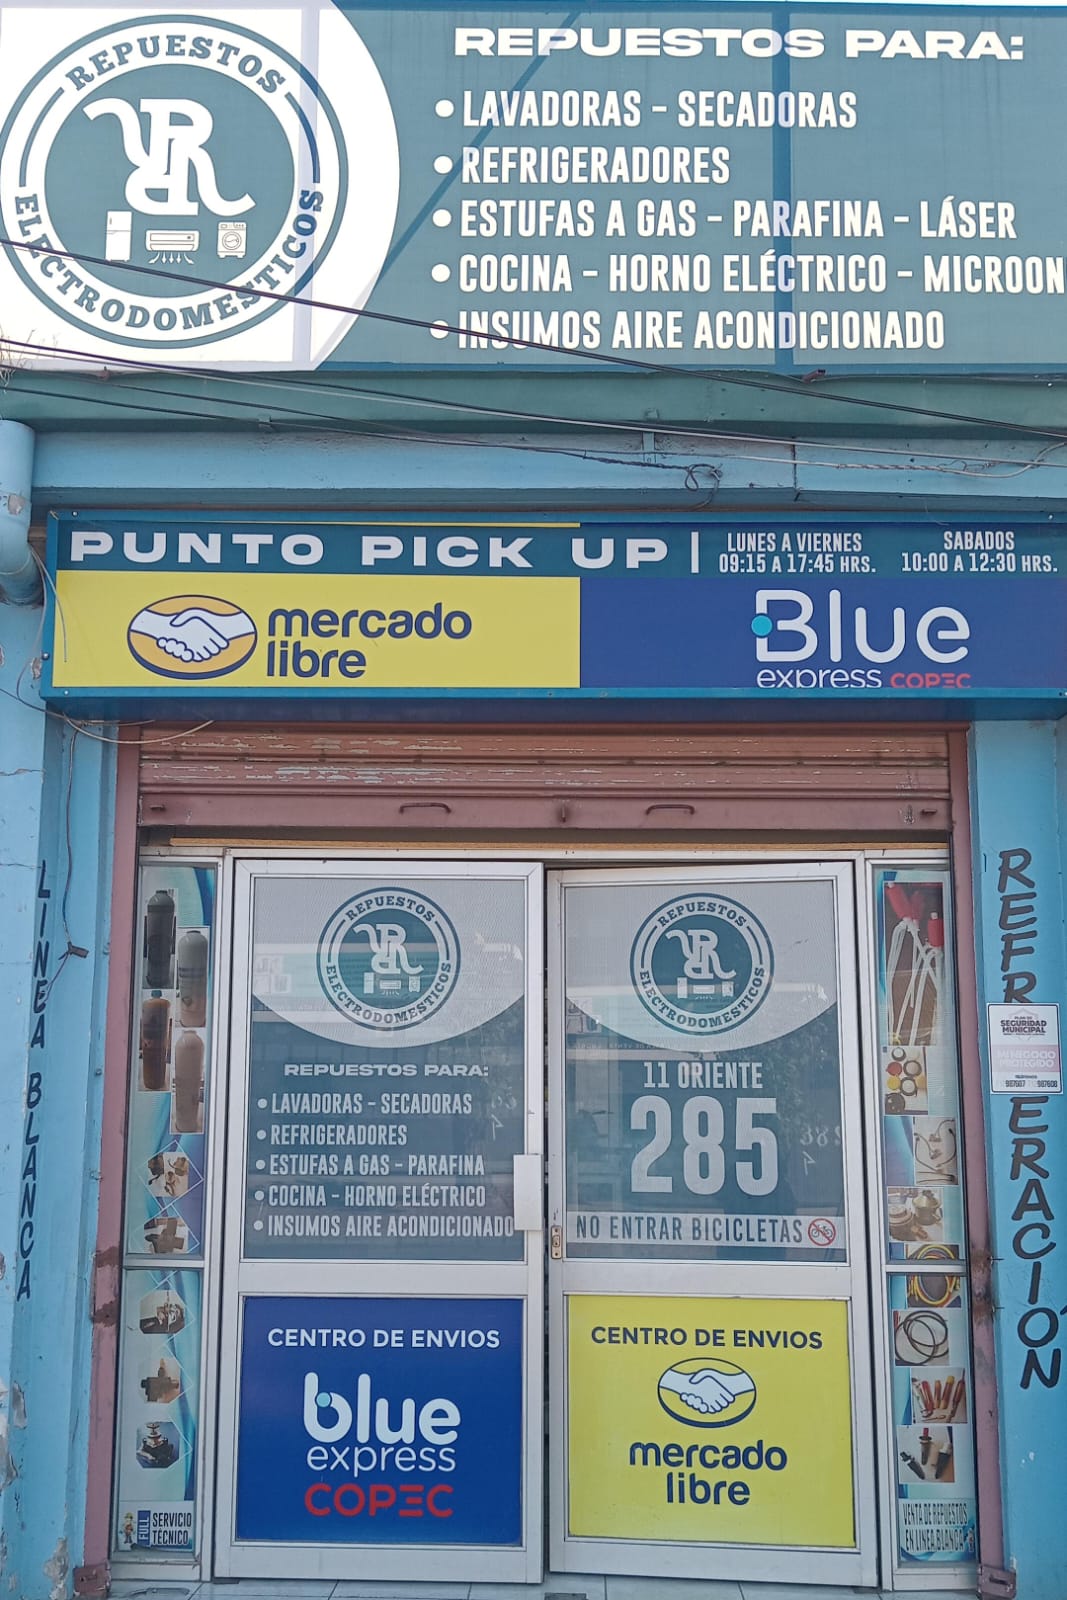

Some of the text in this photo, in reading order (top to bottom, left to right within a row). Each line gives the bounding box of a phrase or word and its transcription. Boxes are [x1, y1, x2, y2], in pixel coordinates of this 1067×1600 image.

[454, 27, 1024, 60] REPUESTOS PARA:
[65, 35, 287, 94] REPUESTOS
[463, 90, 641, 127] LAVADORAS
[678, 91, 857, 128] SECADORAS
[462, 146, 730, 184] REFRIGERADORES
[461, 199, 595, 237] ESTUFAS
[605, 200, 626, 237] A
[637, 199, 697, 237] GAS
[733, 200, 884, 237] PARAFINA
[920, 195, 1017, 239] LÁSER
[14, 190, 324, 331] ELECTRODOMESTICOS
[459, 254, 573, 292] COCINA
[609, 254, 711, 292] HORNO
[723, 249, 887, 292] ELÉCTRICO
[924, 255, 1066, 294] MICROON
[458, 311, 944, 349] INSUMOS AIRE ACONDICIONADO
[70, 531, 668, 569] PUNTO PICK UP
[727, 532, 862, 552] LUNES A VIERNES
[943, 531, 1015, 550] SABADOS
[719, 553, 876, 573] 09:15 A 17:45 HRS.
[902, 552, 1058, 572] 10:00 A 12:30 HRS.
[267, 602, 473, 639] mercado
[751, 589, 970, 664] Blue
[266, 640, 367, 679] libre
[756, 668, 971, 689] express COPEC
[346, 896, 435, 922] REPUESTOS
[657, 901, 747, 928] REPUESTOS
[326, 962, 452, 1024] ELECTRODOMESTICOS
[639, 967, 765, 1028] ELECTRODOMESTICOS
[17, 860, 51, 1302] LINEA BLANCA
[284, 1064, 489, 1077] REPUESTOS PARA:
[643, 1061, 764, 1089] 11 ORIENTE
[271, 1093, 363, 1114] LAVADORAS
[380, 1093, 472, 1115] SECADORAS
[270, 1124, 408, 1146] REFRIGERADORES
[630, 1095, 779, 1196] 285
[269, 1154, 338, 1176] ESTUFAS
[343, 1154, 354, 1176] A
[359, 1154, 390, 1176] GAS
[408, 1155, 485, 1176] PARAFINA
[268, 1185, 327, 1207] COCINA
[344, 1185, 397, 1207] HORNO
[402, 1182, 486, 1207] ELÉCTRICO
[268, 1215, 514, 1238] INSUMOS AIRE ACONDICIONADO
[576, 1215, 803, 1243] NO ENTRAR BICICLETAS
[267, 1328, 500, 1349] CENTRO DE ENVIOS
[591, 1326, 823, 1349] CENTRO DE ENVIOS
[303, 1371, 461, 1445] blue
[306, 1445, 456, 1478] express
[629, 1440, 788, 1471] mercado
[304, 1483, 454, 1518] COPEC
[666, 1472, 750, 1505] libre
[138, 1516, 150, 1540] FULL
[152, 1512, 192, 1527] SERVICIO
[902, 1503, 968, 1525] VENTA DE REPUESTOS
[152, 1528, 189, 1545] TÉCNICO
[905, 1529, 914, 1551] EN
[936, 1529, 964, 1551] BLANCA
